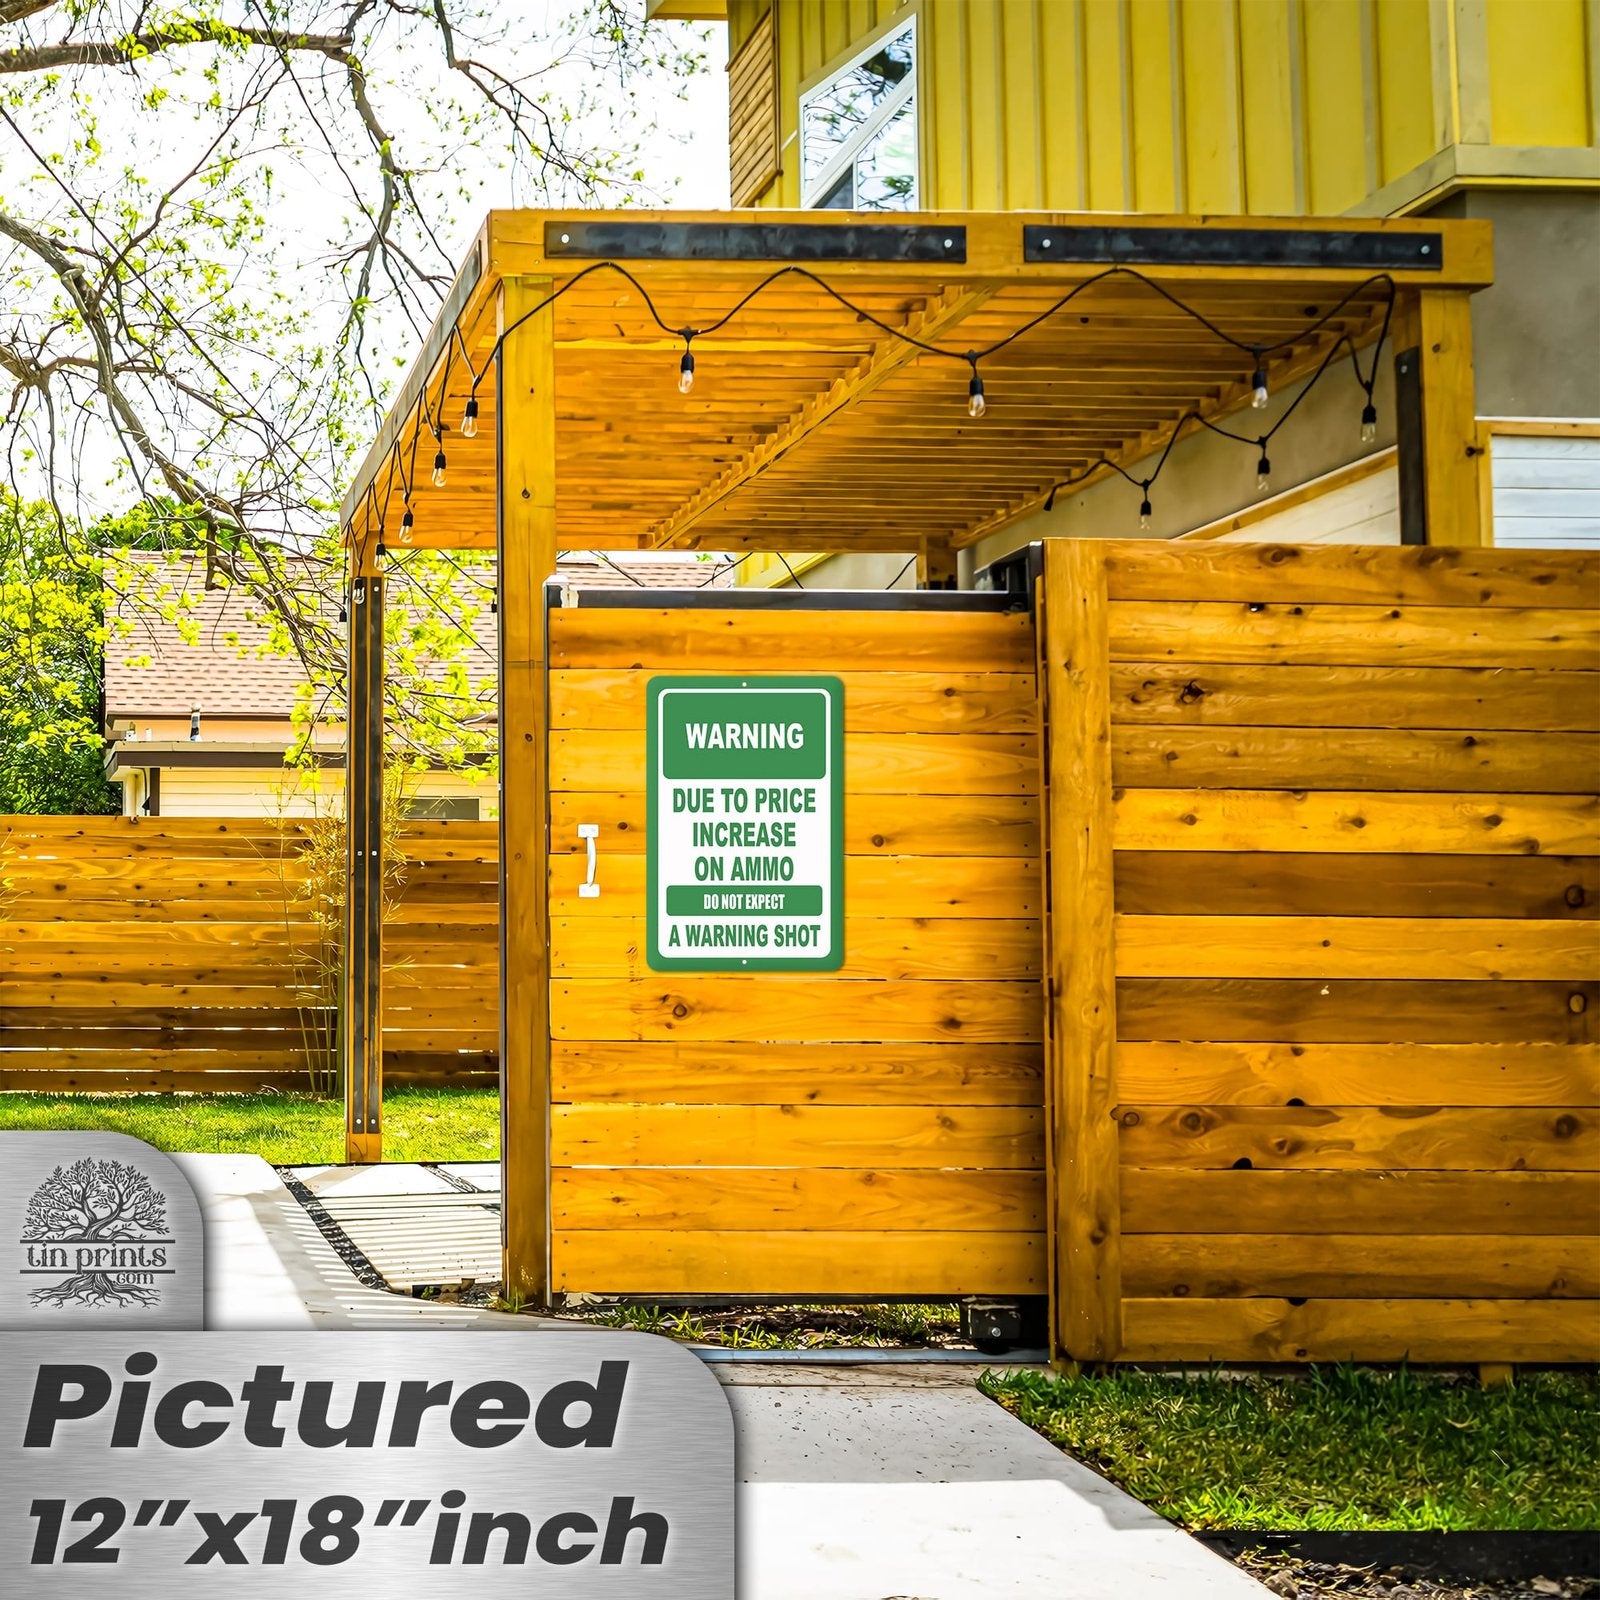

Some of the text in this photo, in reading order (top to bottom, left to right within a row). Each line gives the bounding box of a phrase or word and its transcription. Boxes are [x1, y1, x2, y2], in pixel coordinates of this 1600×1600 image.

[686, 723, 804, 749] WARNING
[673, 788, 816, 813] DUE TO PRICE
[692, 822, 796, 847] INCREASE
[694, 856, 794, 881] ON AMMO
[703, 894, 785, 910] DO NOT EXPECT
[668, 924, 821, 947] A WARNING SHOT
